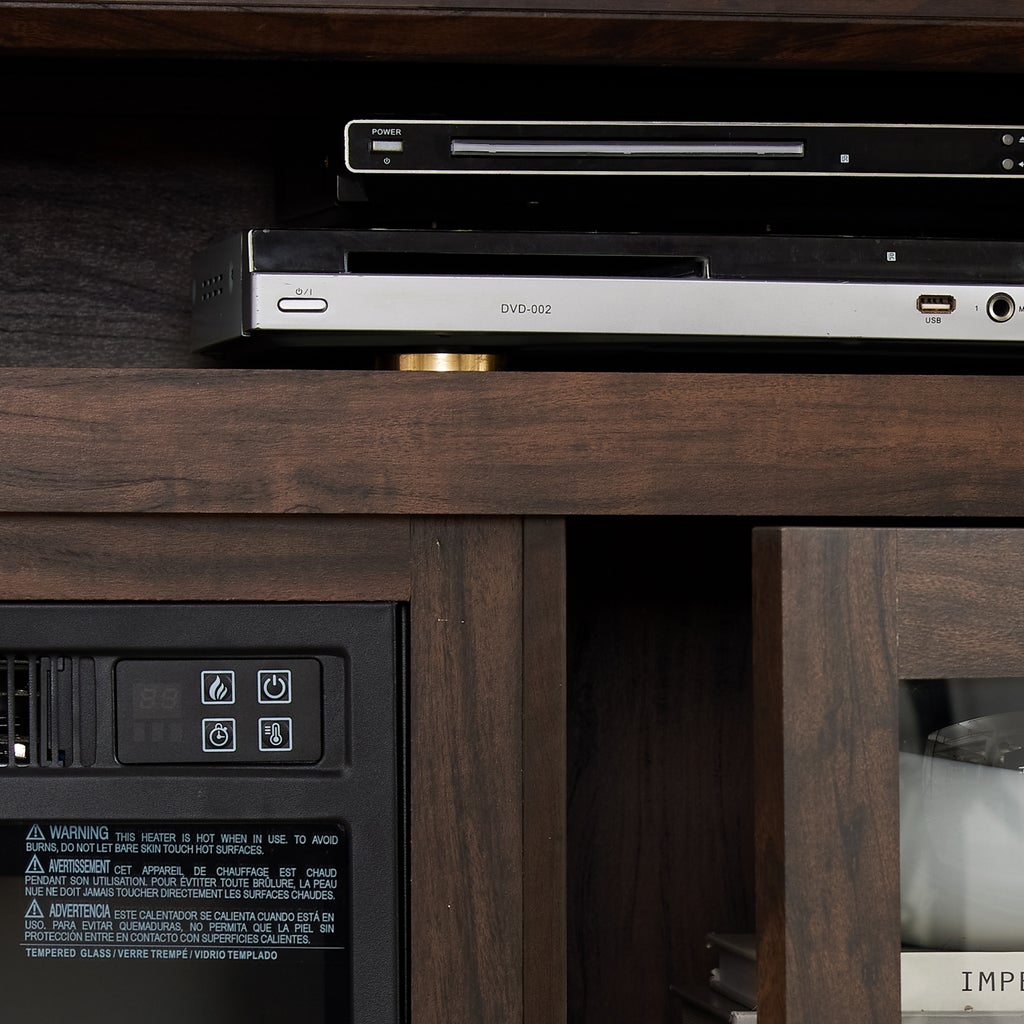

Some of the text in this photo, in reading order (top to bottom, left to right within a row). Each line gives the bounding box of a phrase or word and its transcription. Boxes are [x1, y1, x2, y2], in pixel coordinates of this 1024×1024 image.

[372, 128, 402, 136] POWER
[501, 304, 552, 314] DVD-002
[50, 826, 338, 845] WARNING THIS HEATER IS HOT WHEN IN USE. TO AVOID
[26, 842, 264, 855] BURNS, DO NOT LET BARE SKIN TOUCH HOT SURFACES.
[49, 859, 337, 877] AVERTISSEMENT CET APPAREIL DE CHAUFFAGE EST CHAUD
[25, 875, 67, 885] PENDANT
[70, 876, 89, 885] SON
[151, 877, 176, 886] POUR
[221, 878, 249, 887] TOUTE
[300, 879, 310, 888] LA
[313, 879, 337, 888] PEAU
[25, 887, 335, 900] NUE NE DOIT JAMAIS TOUCHER DIRECTEMENT LES SURFACES CHAUDES.
[50, 904, 334, 921] ADVERTENCIA ESTE CALENTADOR SE CALIENTA CUANDO ESTÁ EN
[25, 920, 334, 933] USO. PARA EVITAR QUEMADURAS, NO PERMITA QUE LA PIEL SIN
[25, 930, 310, 944] PROTECCIÓN ENTRE EN CONTACTO CON SUPERFICIES CALIENTES.
[26, 948, 76, 957] TEMPERED
[81, 949, 111, 957] GLASS
[118, 949, 148, 958] VERRE
[151, 948, 188, 959] TREMPÉ
[195, 950, 225, 959] VIDRIO
[228, 951, 277, 959] TEMPLADO
